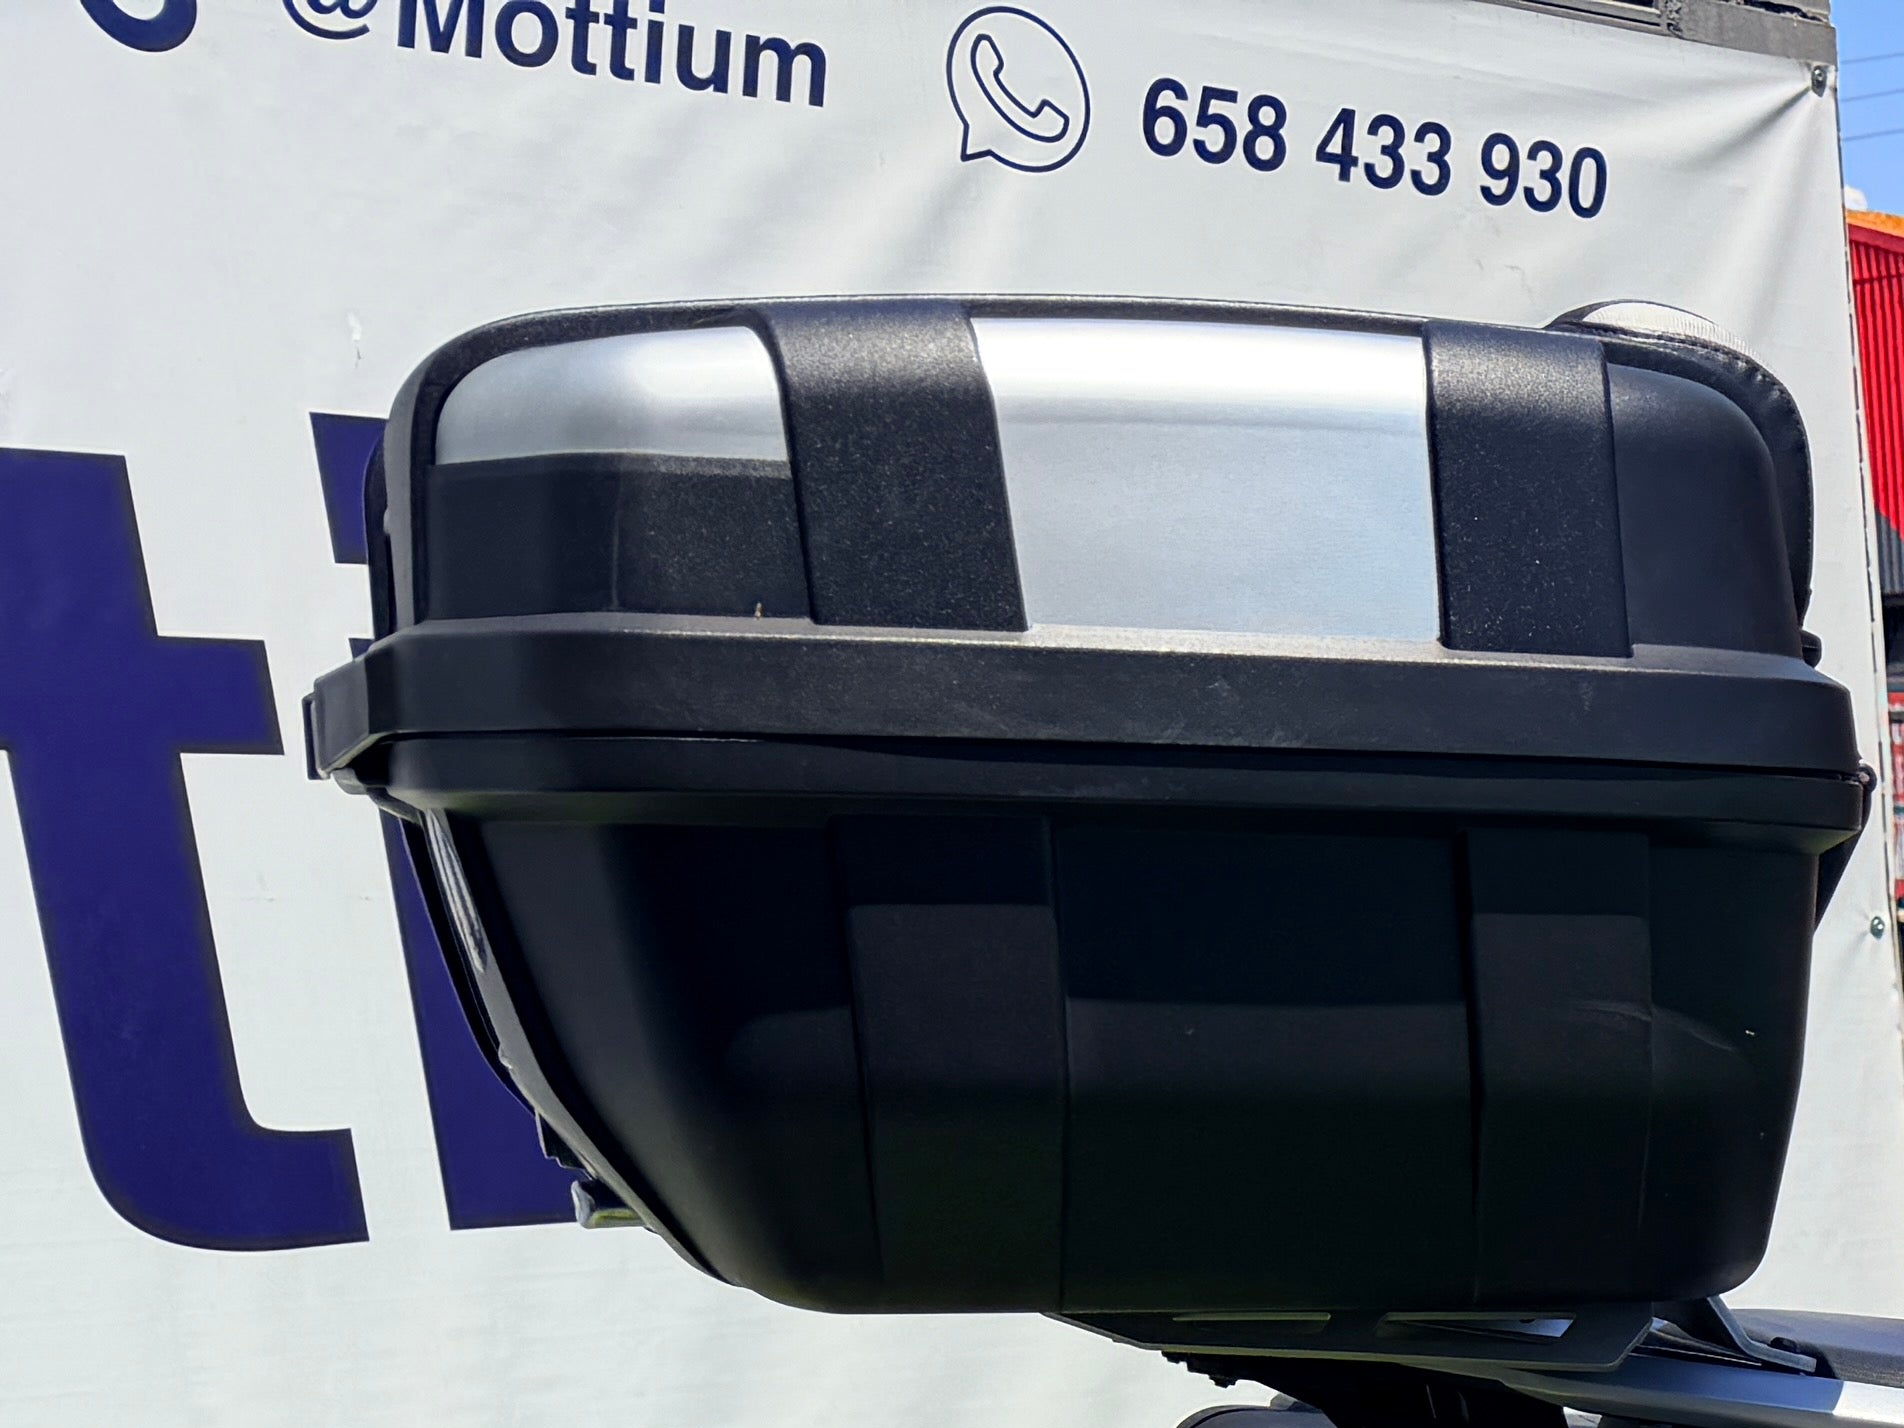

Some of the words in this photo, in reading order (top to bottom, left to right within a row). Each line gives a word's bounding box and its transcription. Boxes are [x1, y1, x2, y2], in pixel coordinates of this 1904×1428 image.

[1142, 77, 1287, 172] 658
[1315, 107, 1452, 196] 433
[1479, 132, 1607, 218] 930
